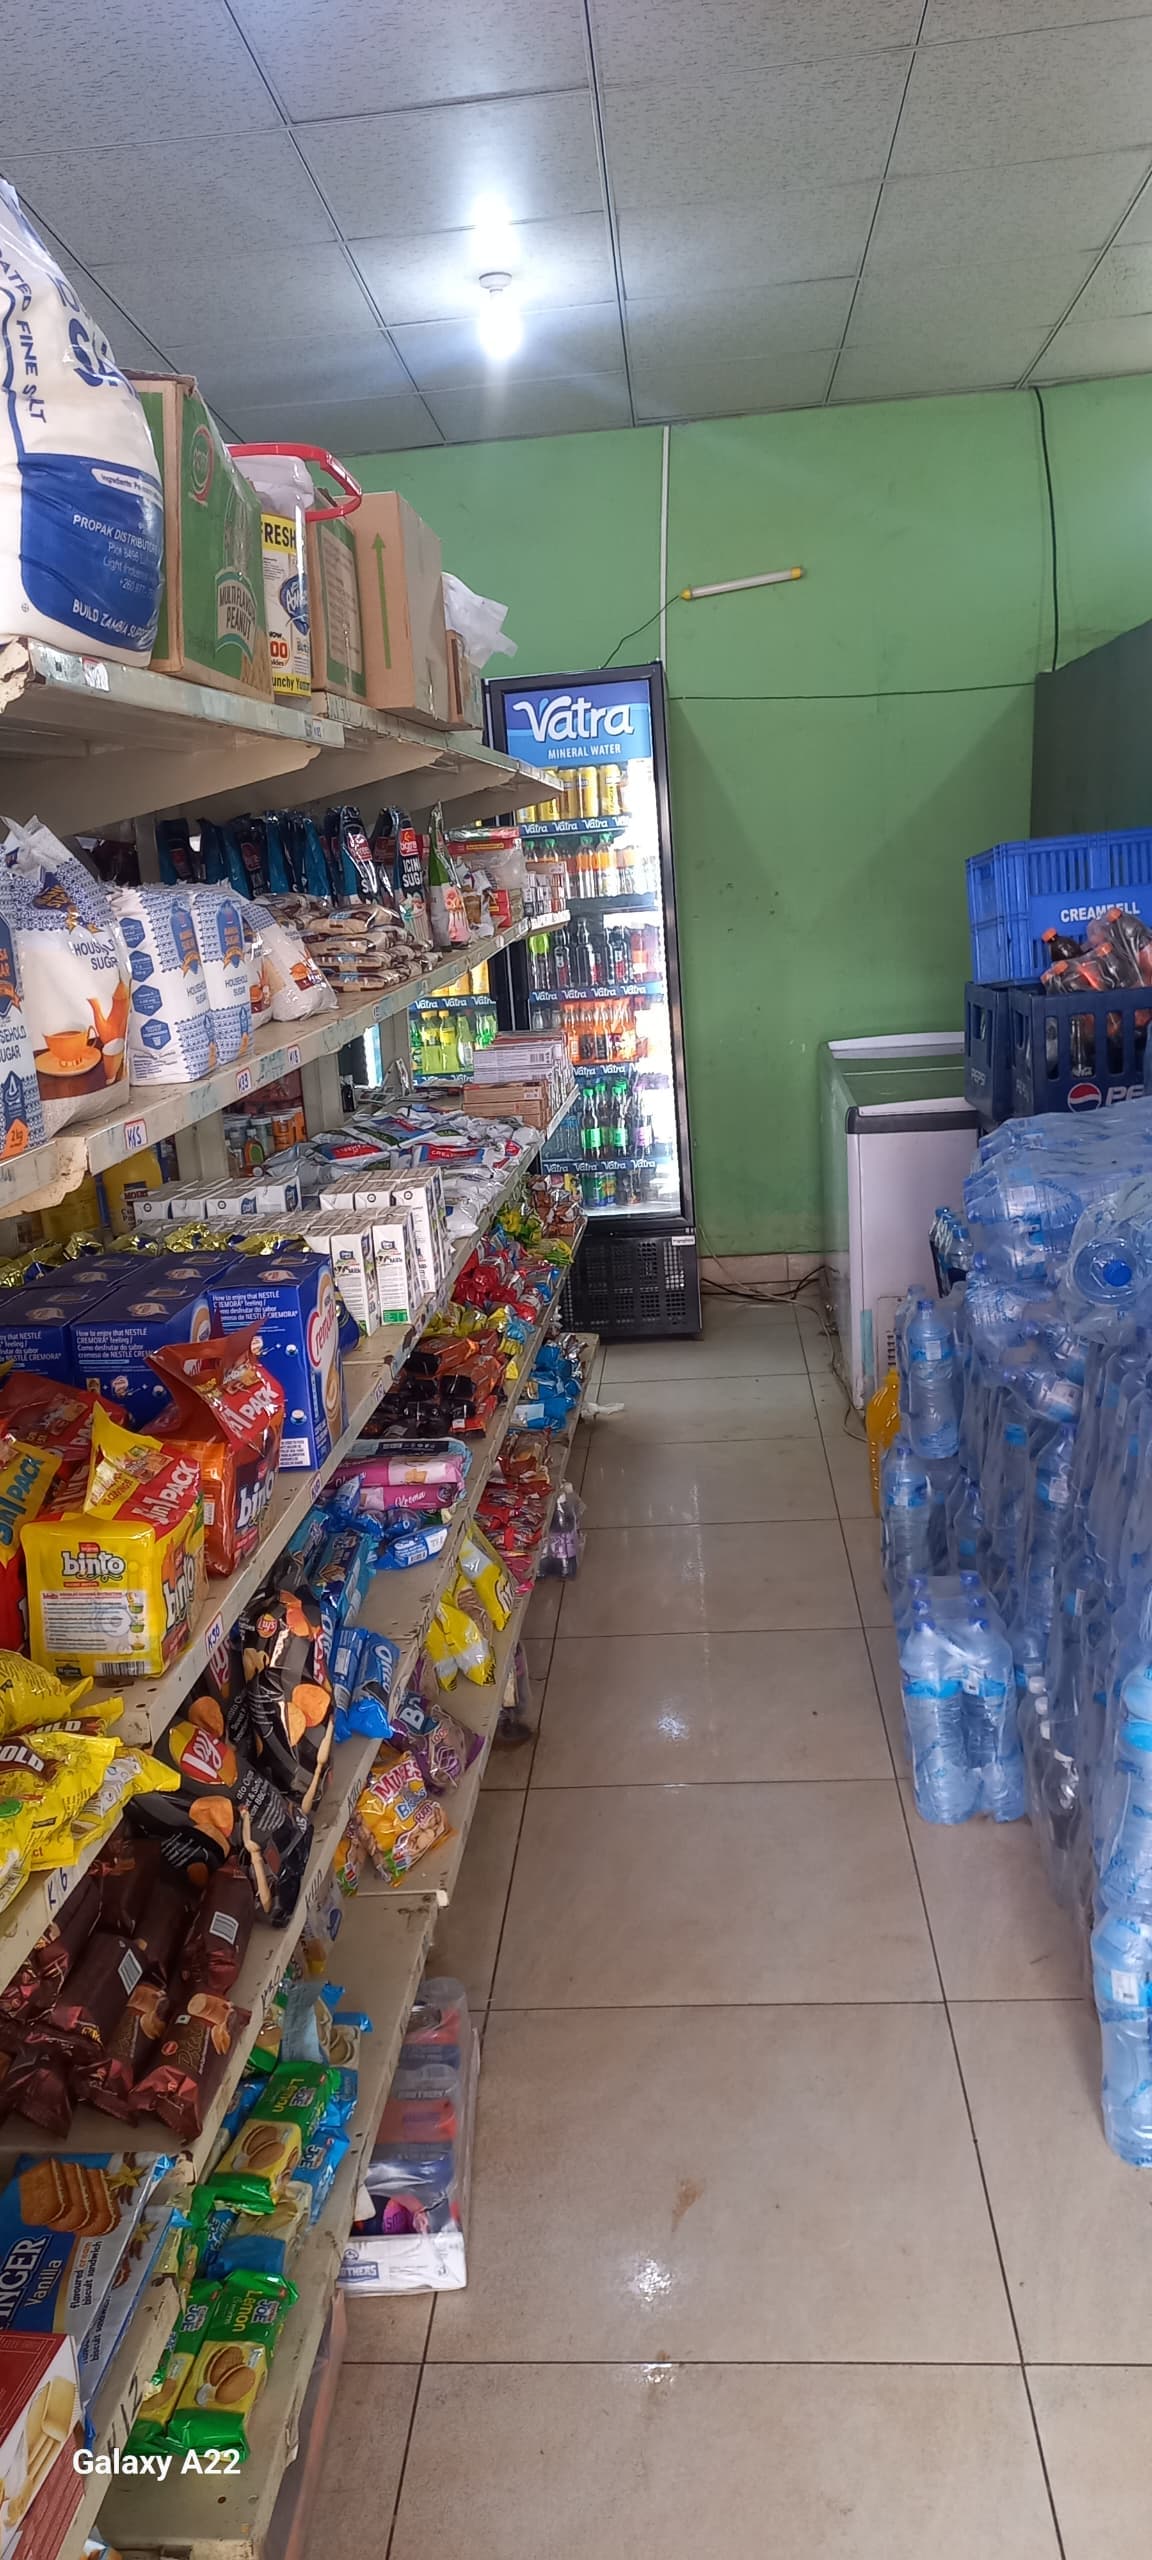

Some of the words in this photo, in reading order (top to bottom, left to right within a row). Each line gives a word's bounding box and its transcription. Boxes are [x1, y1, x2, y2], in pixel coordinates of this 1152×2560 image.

[0, 252, 32, 312] ATED
[16, 320, 38, 376] FINE
[72, 514, 113, 538] PROPAK
[72, 598, 99, 623] BUILD
[100, 612, 128, 634] ZAMBIA
[226, 605, 251, 641] PEANUT
[513, 695, 635, 743] Vatra
[548, 748, 588, 760] MINERAL
[590, 743, 622, 756] WATER
[523, 823, 548, 834] Vatra
[552, 821, 578, 832] Vatra
[582, 819, 608, 830] Vatra
[414, 1000, 438, 1010] Vatra
[442, 998, 467, 1008] Vatra
[533, 991, 557, 1000] Vatra
[562, 990, 587, 1000] Vatra
[591, 988, 617, 998] Vatra
[620, 985, 646, 995] Vatra
[573, 1067, 597, 1078] Vatra
[601, 1064, 626, 1075] Vatra
[544, 1163, 569, 1173] Vatra
[574, 1162, 598, 1172] Vatra
[601, 1160, 626, 1170] Vatra
[630, 1158, 656, 1169] Vatra
[258, 1290, 280, 1299] NESTLÉ
[124, 1328, 148, 1336] NESTLÉ
[7, 1454, 44, 1502] PACK
[159, 1459, 200, 1501] PACK
[375, 1645, 393, 1695] OREO
[182, 1728, 223, 1779] Lay's
[272, 2078, 305, 2114] Lemon
[24, 2259, 63, 2307] Vanilla
[69, 2269, 84, 2310] flavoured
[79, 2241, 92, 2269] cream
[82, 2279, 94, 2306] biscuit
[88, 2240, 103, 2277] sandwich
[232, 2290, 263, 2332] Lemon
